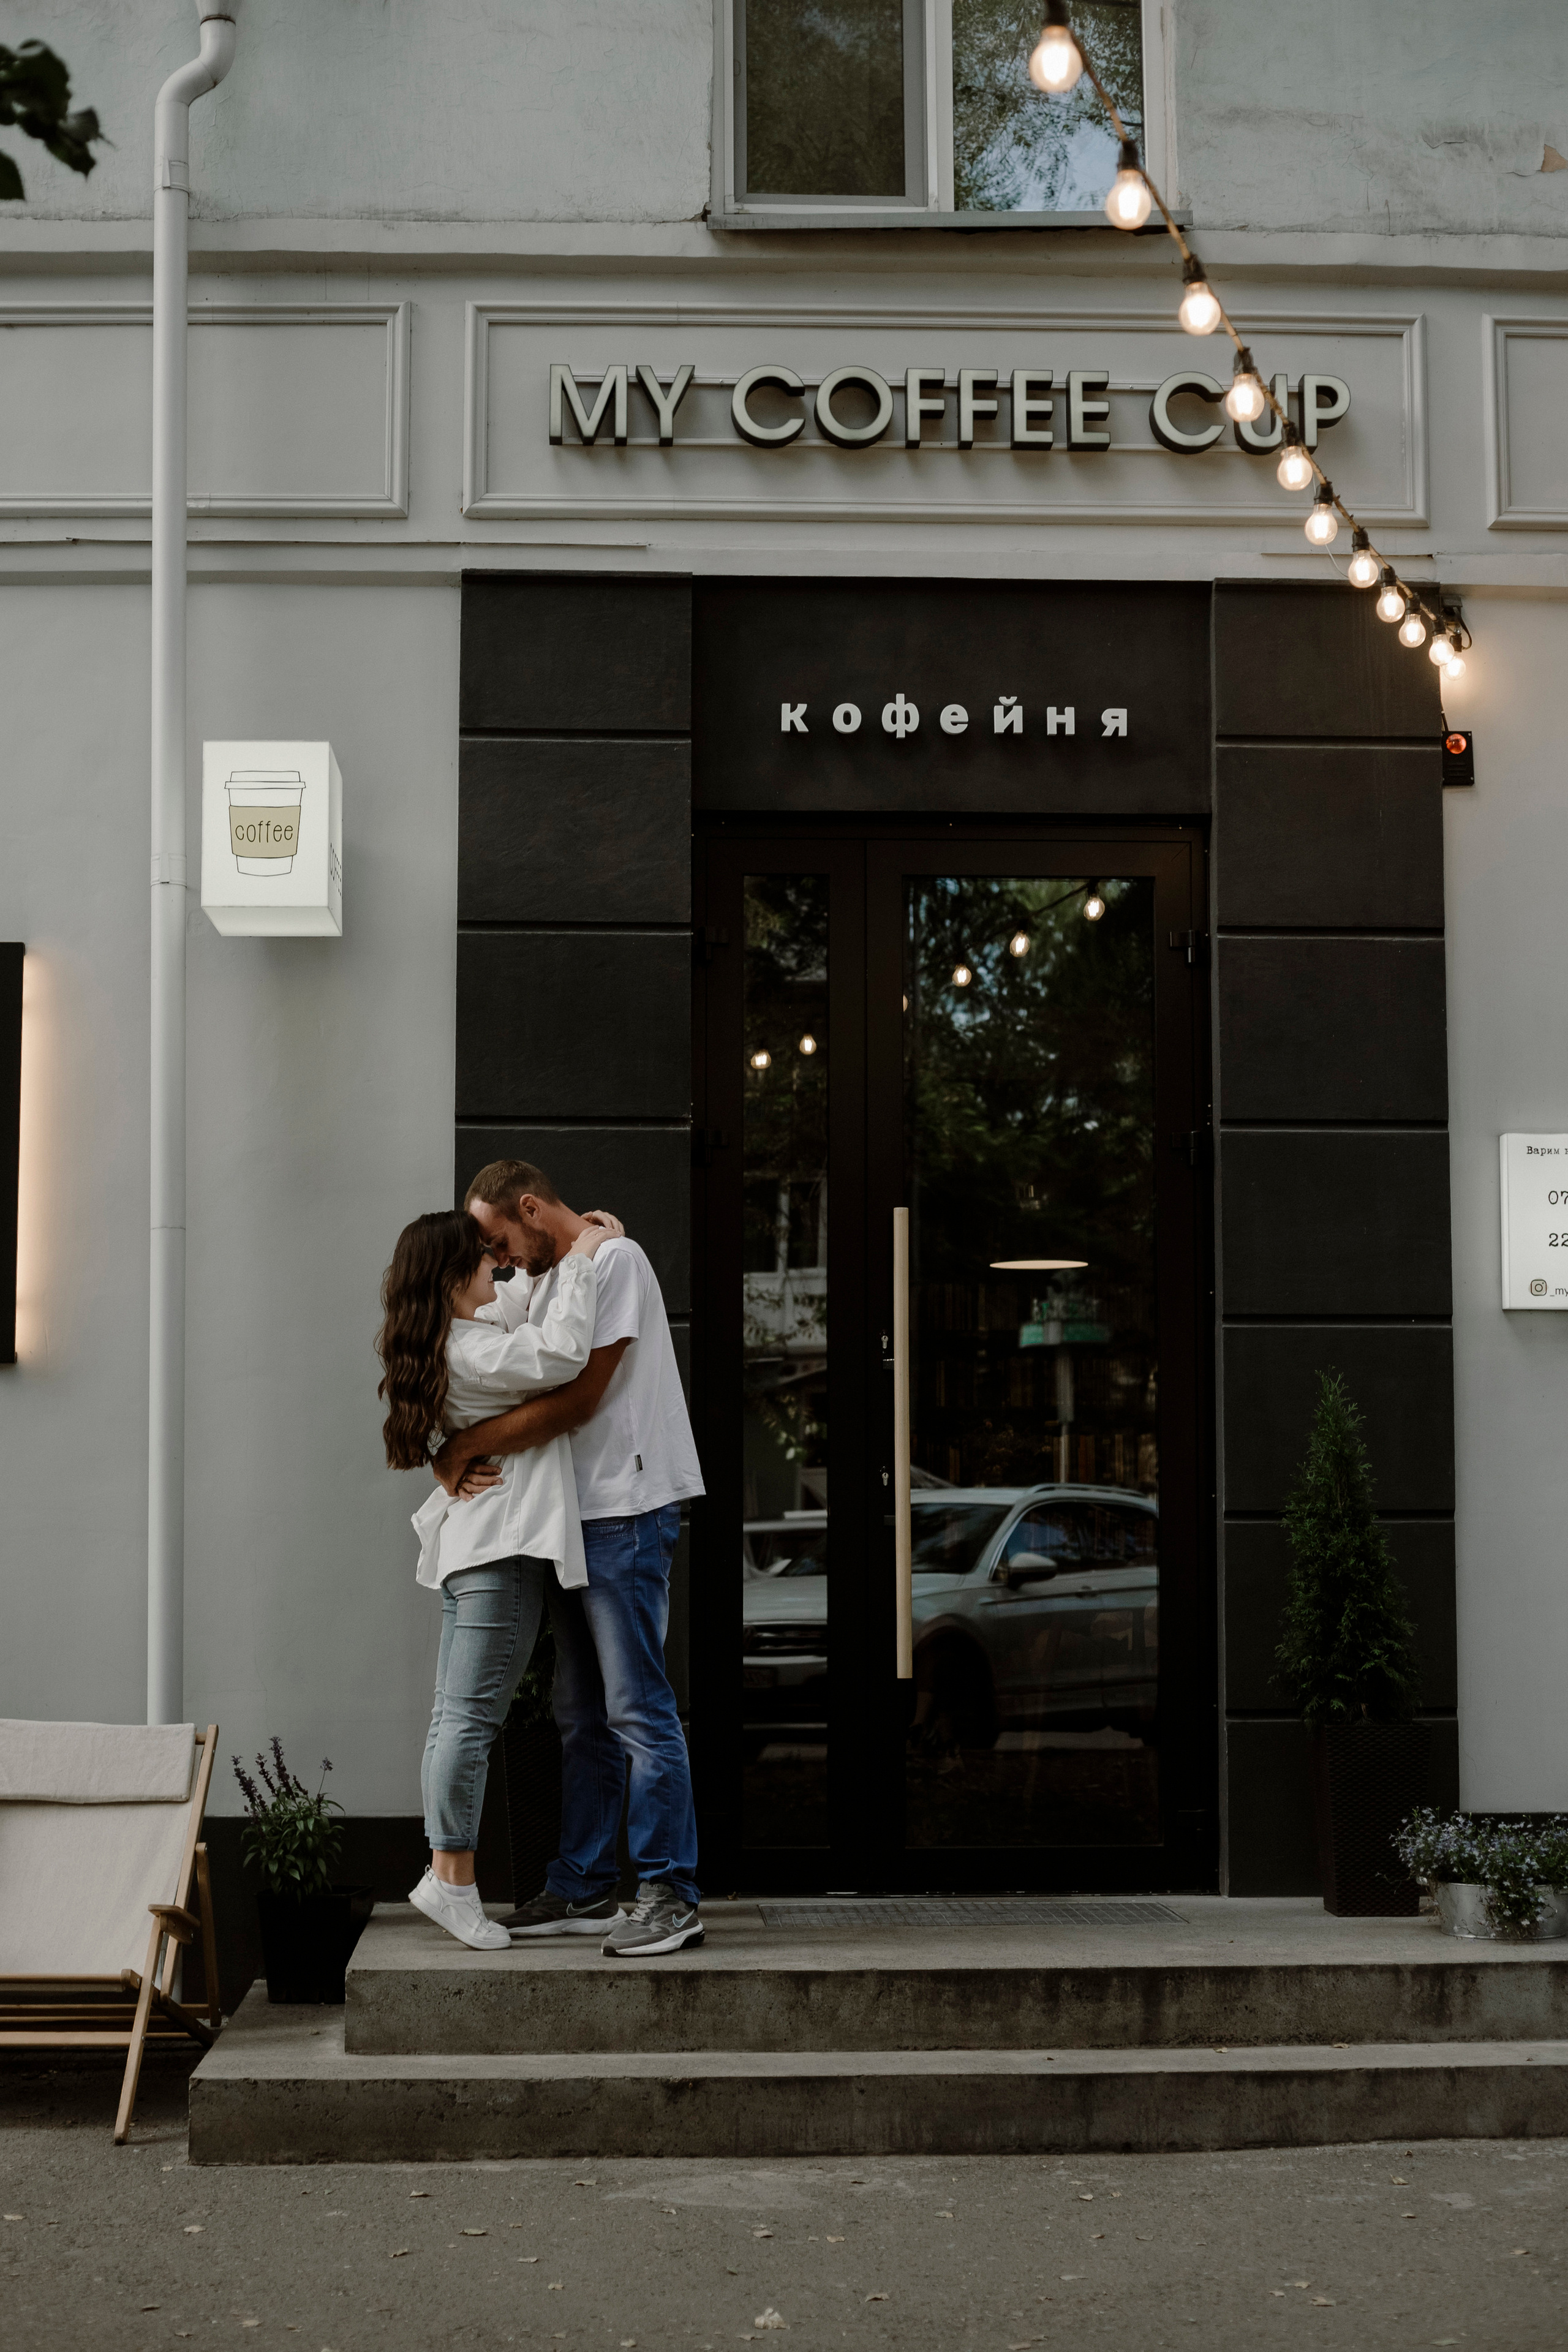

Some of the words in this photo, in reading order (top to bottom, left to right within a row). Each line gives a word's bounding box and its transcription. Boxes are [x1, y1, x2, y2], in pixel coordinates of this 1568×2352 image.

[549, 364, 695, 447] MY
[731, 364, 1111, 452] COFFEE
[1149, 371, 1352, 455] CUP
[781, 693, 1128, 739] кофейня
[235, 820, 293, 843] coffee
[1526, 1146, 1560, 1156] Варим
[1548, 1233, 1568, 1247] 22
